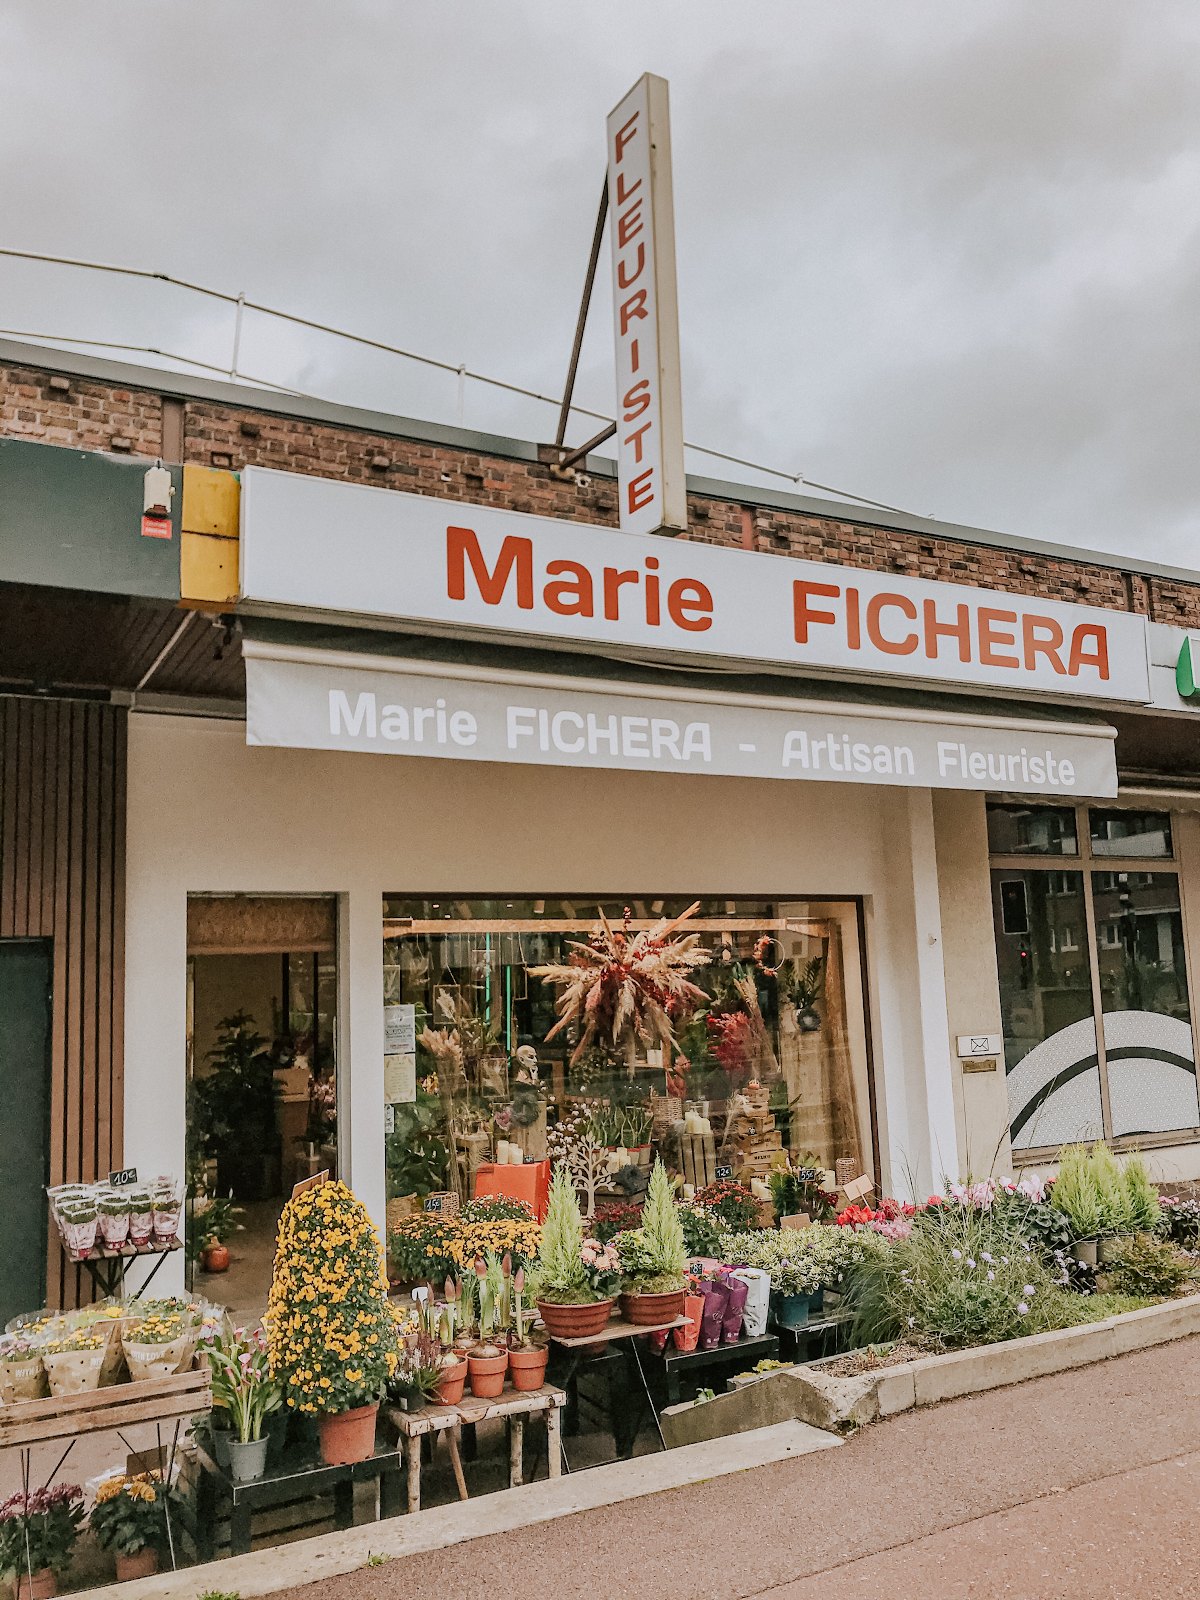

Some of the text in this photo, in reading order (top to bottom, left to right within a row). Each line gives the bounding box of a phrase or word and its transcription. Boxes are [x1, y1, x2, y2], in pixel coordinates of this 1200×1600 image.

[614, 110, 655, 516] FLEURISTE
[446, 526, 1110, 681] Marie FICHERA
[328, 688, 478, 746] Marie
[506, 705, 712, 762] FICHERA
[781, 729, 915, 776] Artisan
[936, 740, 1076, 786] Fleuriste
[113, 1170, 136, 1186] 10€
